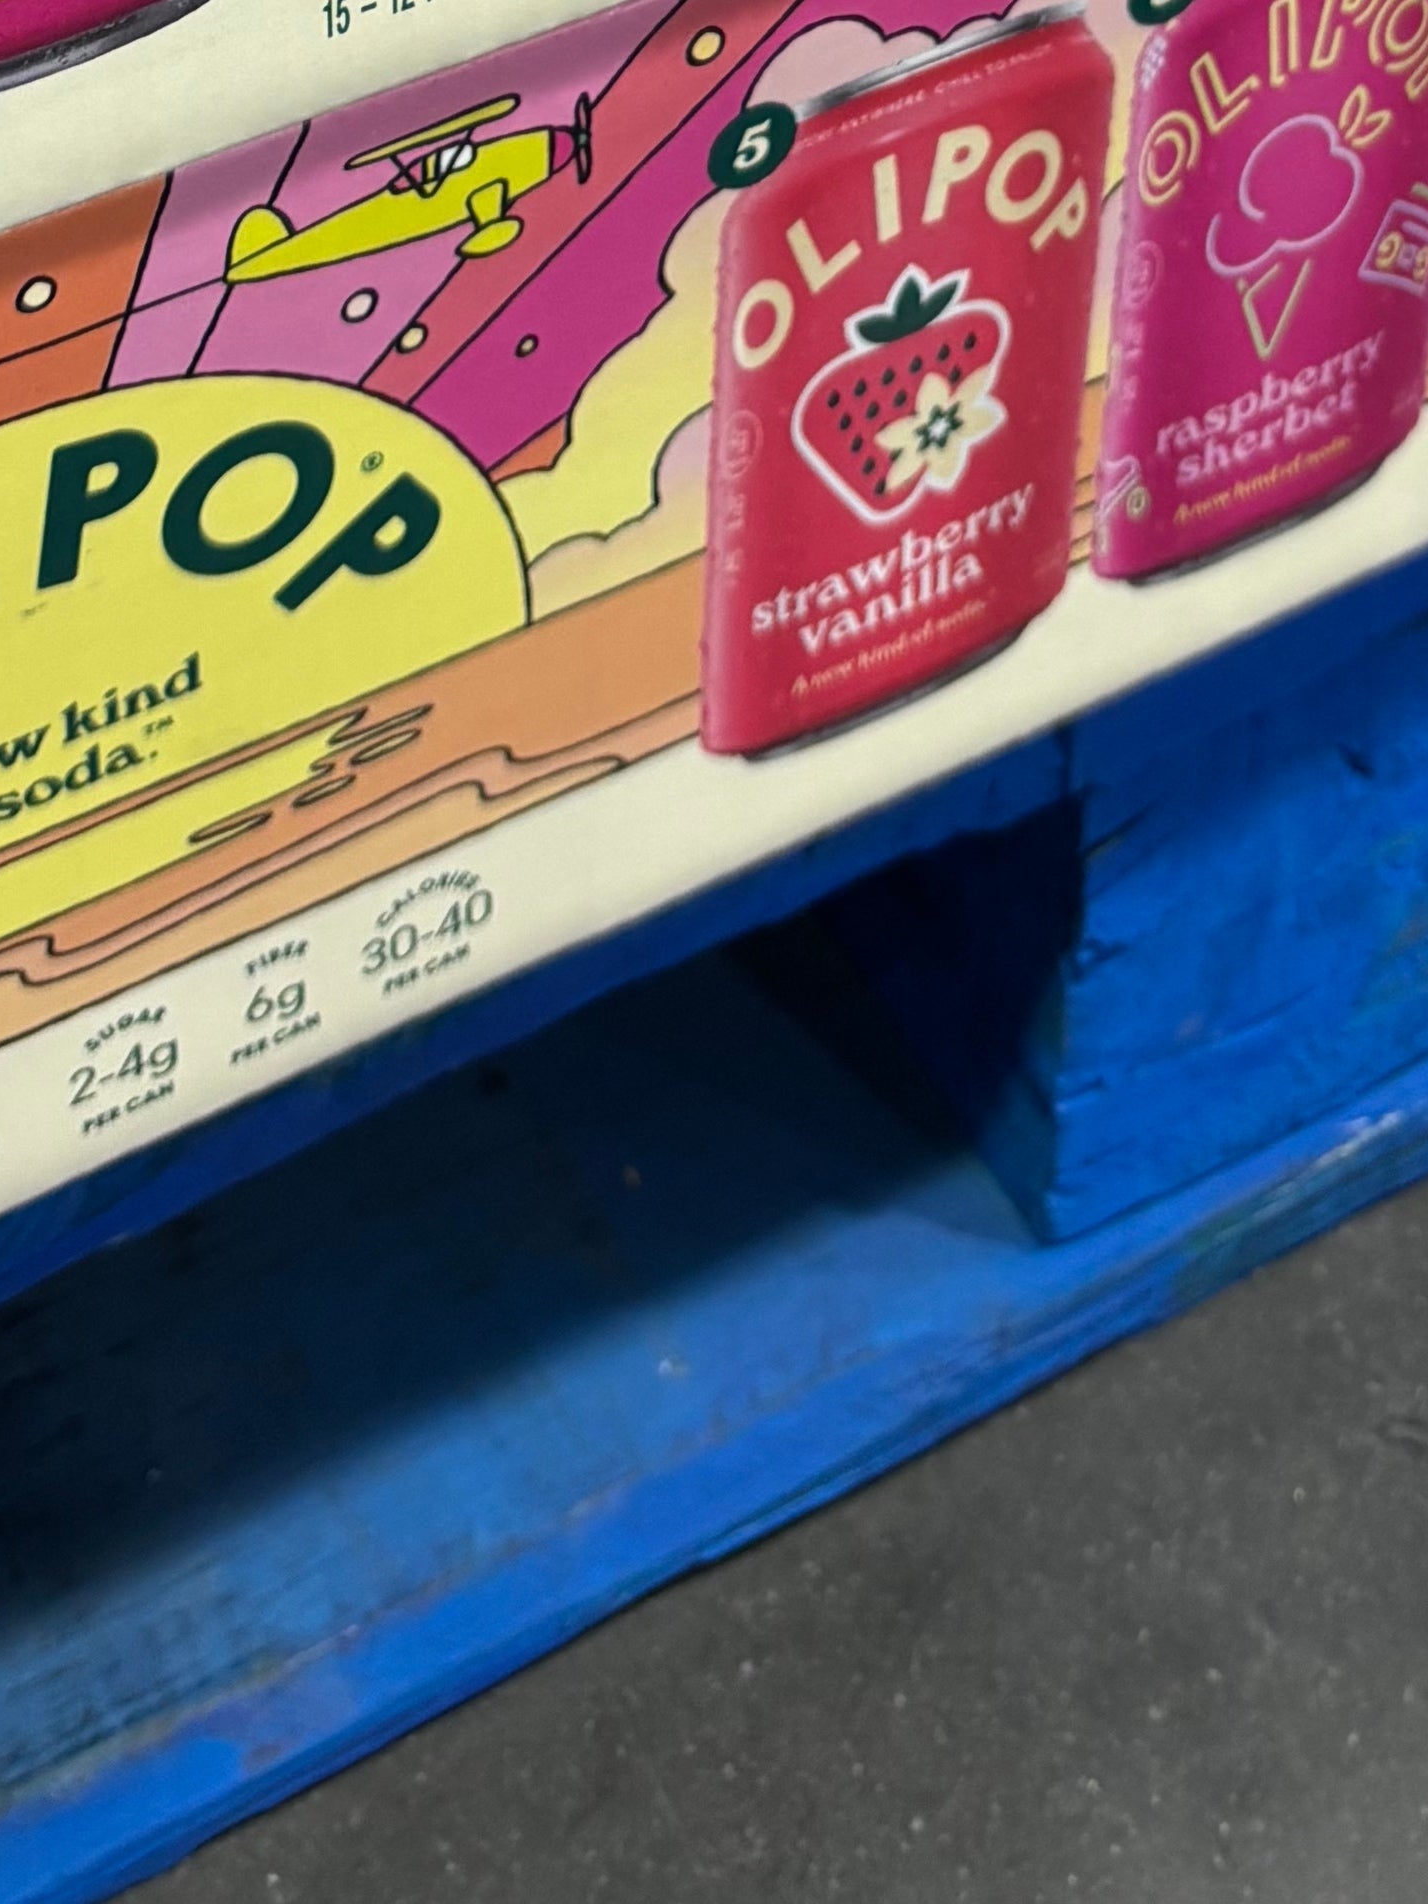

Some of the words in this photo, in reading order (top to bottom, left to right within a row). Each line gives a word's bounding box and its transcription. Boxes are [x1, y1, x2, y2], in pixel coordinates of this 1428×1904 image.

[733, 119, 770, 170] 5
[733, 125, 1087, 370] OLIPOP
[1156, 331, 1384, 455] raspberry
[1176, 380, 1358, 487] sherbet
[751, 484, 1035, 631] strawberry
[799, 553, 983, 655] vanilla
